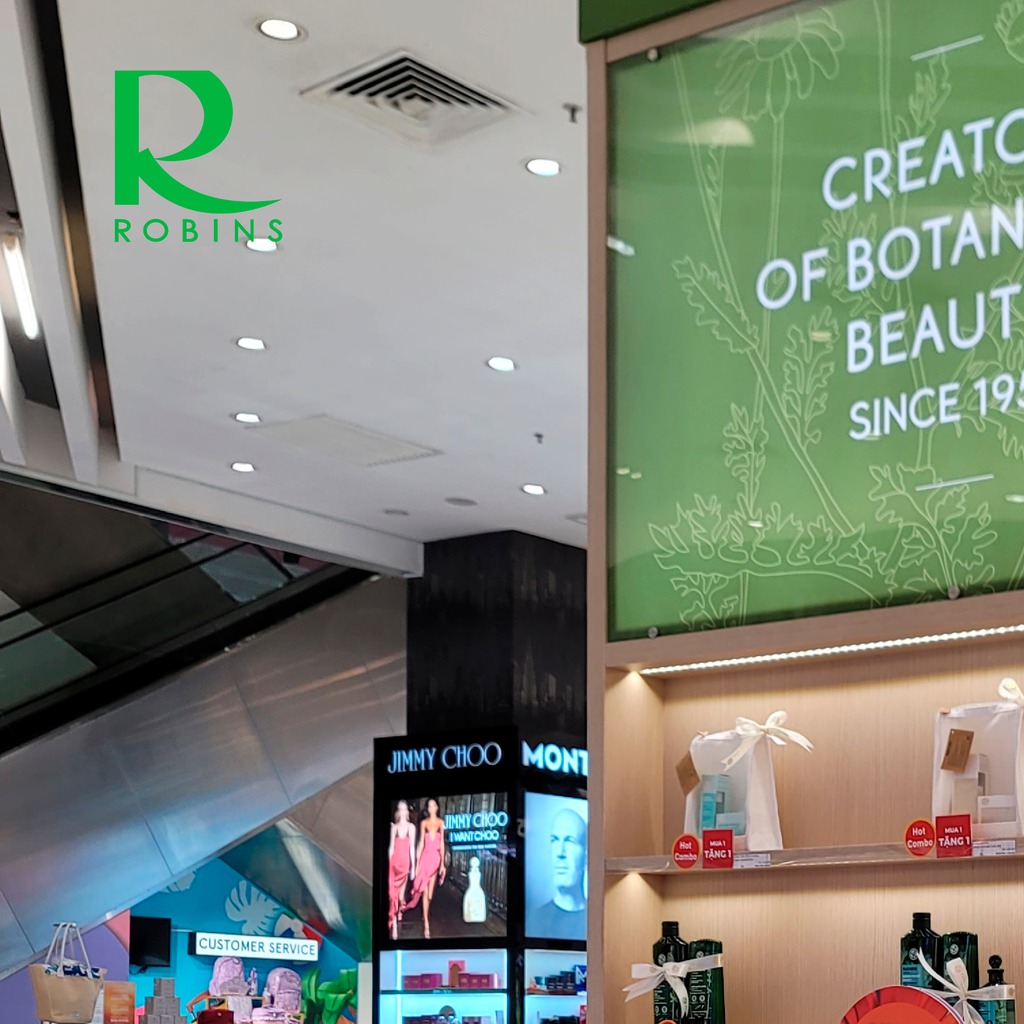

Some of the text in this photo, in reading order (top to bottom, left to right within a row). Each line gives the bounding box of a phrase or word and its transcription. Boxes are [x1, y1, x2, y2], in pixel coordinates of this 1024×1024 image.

[756, 248, 829, 310] OF
[849, 382, 960, 440] SINCE
[388, 741, 502, 774] JIMMY CHOO
[443, 811, 508, 830] JIMMY CHOO
[453, 830, 474, 842] WANT
[474, 829, 499, 841] CHOO
[911, 827, 926, 836] Hot
[679, 841, 692, 850] Hot
[907, 838, 934, 849] Combo
[938, 835, 971, 849] TẶNG 1
[674, 851, 697, 862] Combo
[704, 847, 727, 860] TẶNG
[727, 850, 732, 858] 1
[199, 937, 316, 955] CUSTOMER SERVICE
